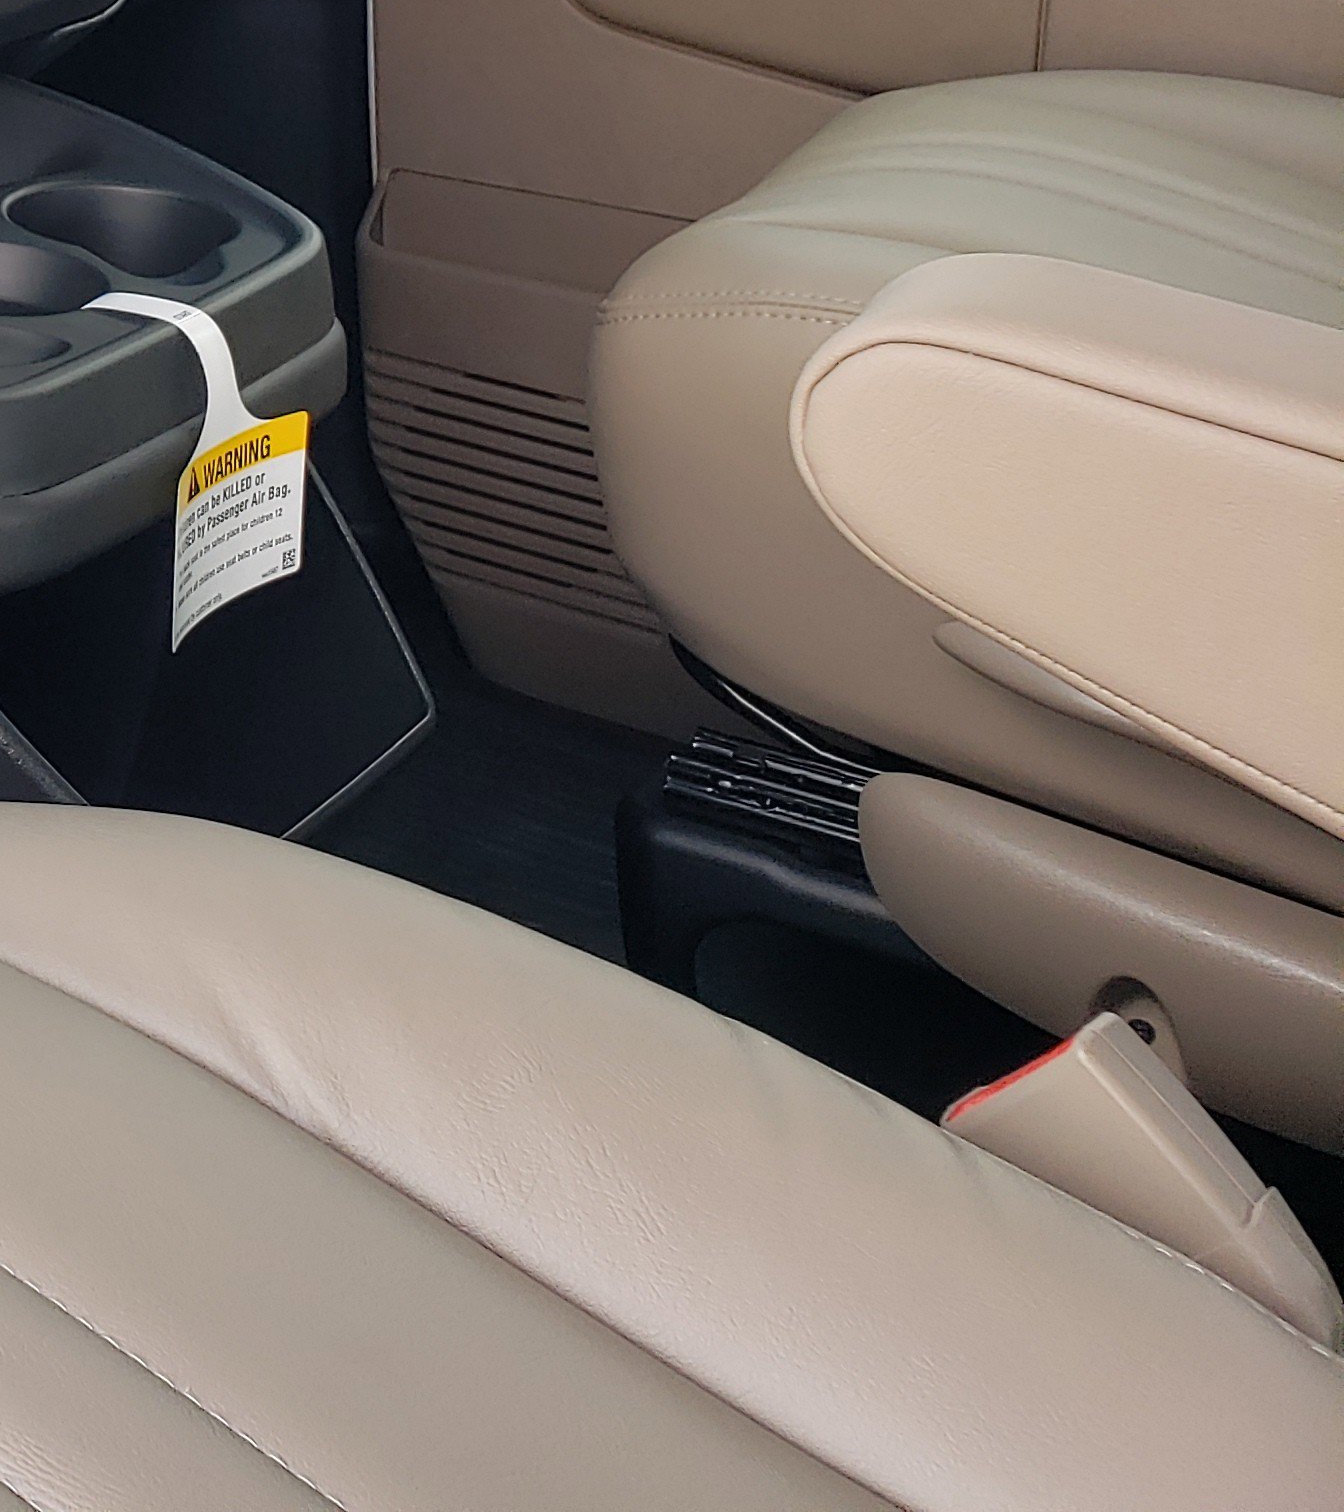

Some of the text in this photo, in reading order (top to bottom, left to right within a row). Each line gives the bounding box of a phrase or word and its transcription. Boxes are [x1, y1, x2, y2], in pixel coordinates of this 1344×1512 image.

[203, 434, 271, 489] WARNING
[196, 472, 265, 520] can be KILLED or
[197, 523, 205, 539] by
[207, 498, 249, 531] Passenger
[251, 491, 266, 507] Air
[268, 484, 291, 500] Bag.
